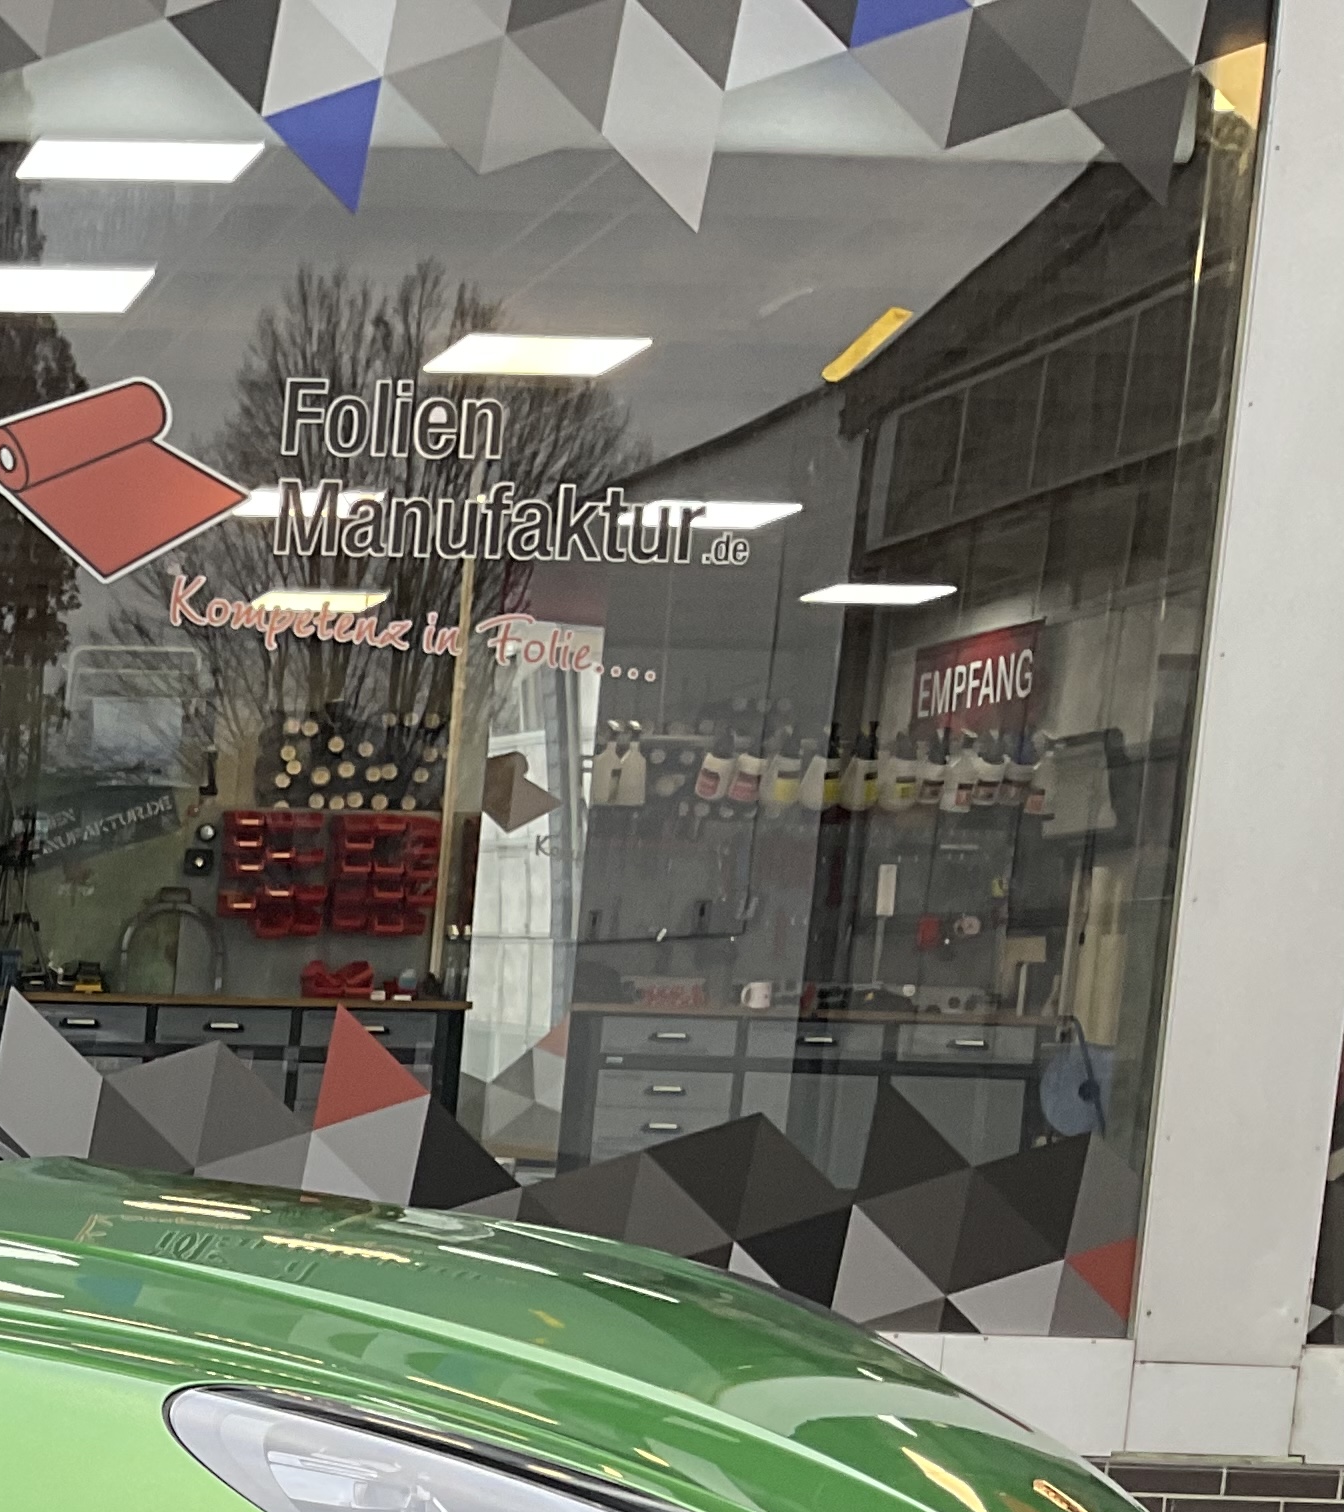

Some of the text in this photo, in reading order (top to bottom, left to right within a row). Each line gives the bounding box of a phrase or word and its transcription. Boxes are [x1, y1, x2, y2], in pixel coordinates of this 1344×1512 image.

[280, 377, 504, 460] Folien
[168, 573, 410, 652] Kompetenz
[423, 611, 464, 656] in
[916, 648, 1034, 719] EMPFANG
